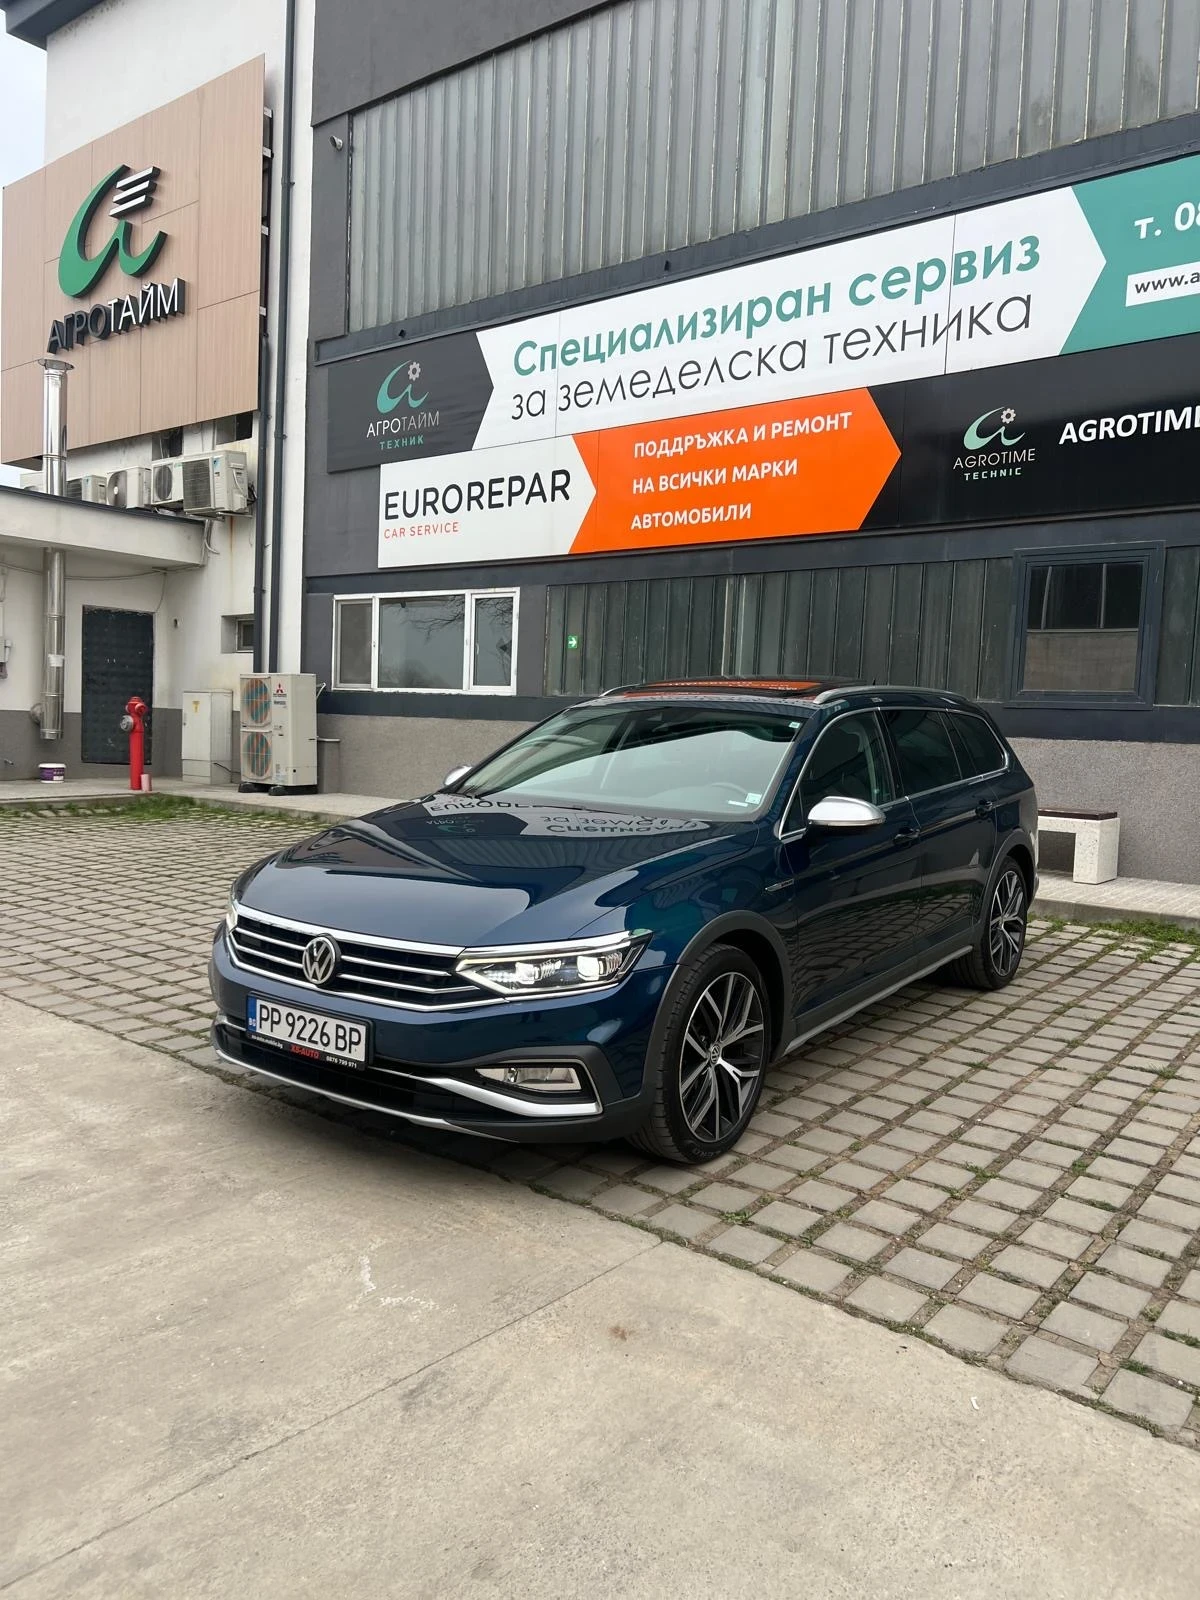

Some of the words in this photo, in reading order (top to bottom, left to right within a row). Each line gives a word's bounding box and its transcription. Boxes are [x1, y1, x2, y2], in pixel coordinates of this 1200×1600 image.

[1174, 201, 1200, 231] 0
[47, 278, 184, 354] АГРОТАЙМ
[513, 282, 831, 376] Специализиран
[849, 235, 1040, 305] сервиз
[511, 389, 546, 420] за
[558, 339, 806, 412] земеделска
[824, 294, 1031, 364] техника
[366, 410, 440, 438] АГРОТАЙМ
[634, 427, 749, 458] ПОДДРЪЖКА
[753, 424, 766, 442] И
[771, 412, 853, 439] РЕМОНТ
[379, 435, 424, 450] ТЕХНИК
[952, 448, 1036, 470] AGROTIME
[963, 467, 1022, 481] TECHNIC
[632, 478, 654, 494] НА
[659, 467, 727, 492] ВСИЧКИ
[731, 459, 798, 483] МАРКИ
[384, 469, 571, 520] EUROREPAR
[384, 527, 406, 539] CAR
[410, 521, 460, 537] SERVICE
[631, 503, 752, 530] АВТОМОБИЛИ
[259, 1004, 281, 1033] PP
[285, 1011, 331, 1047] 9226
[335, 1023, 362, 1054] BP
